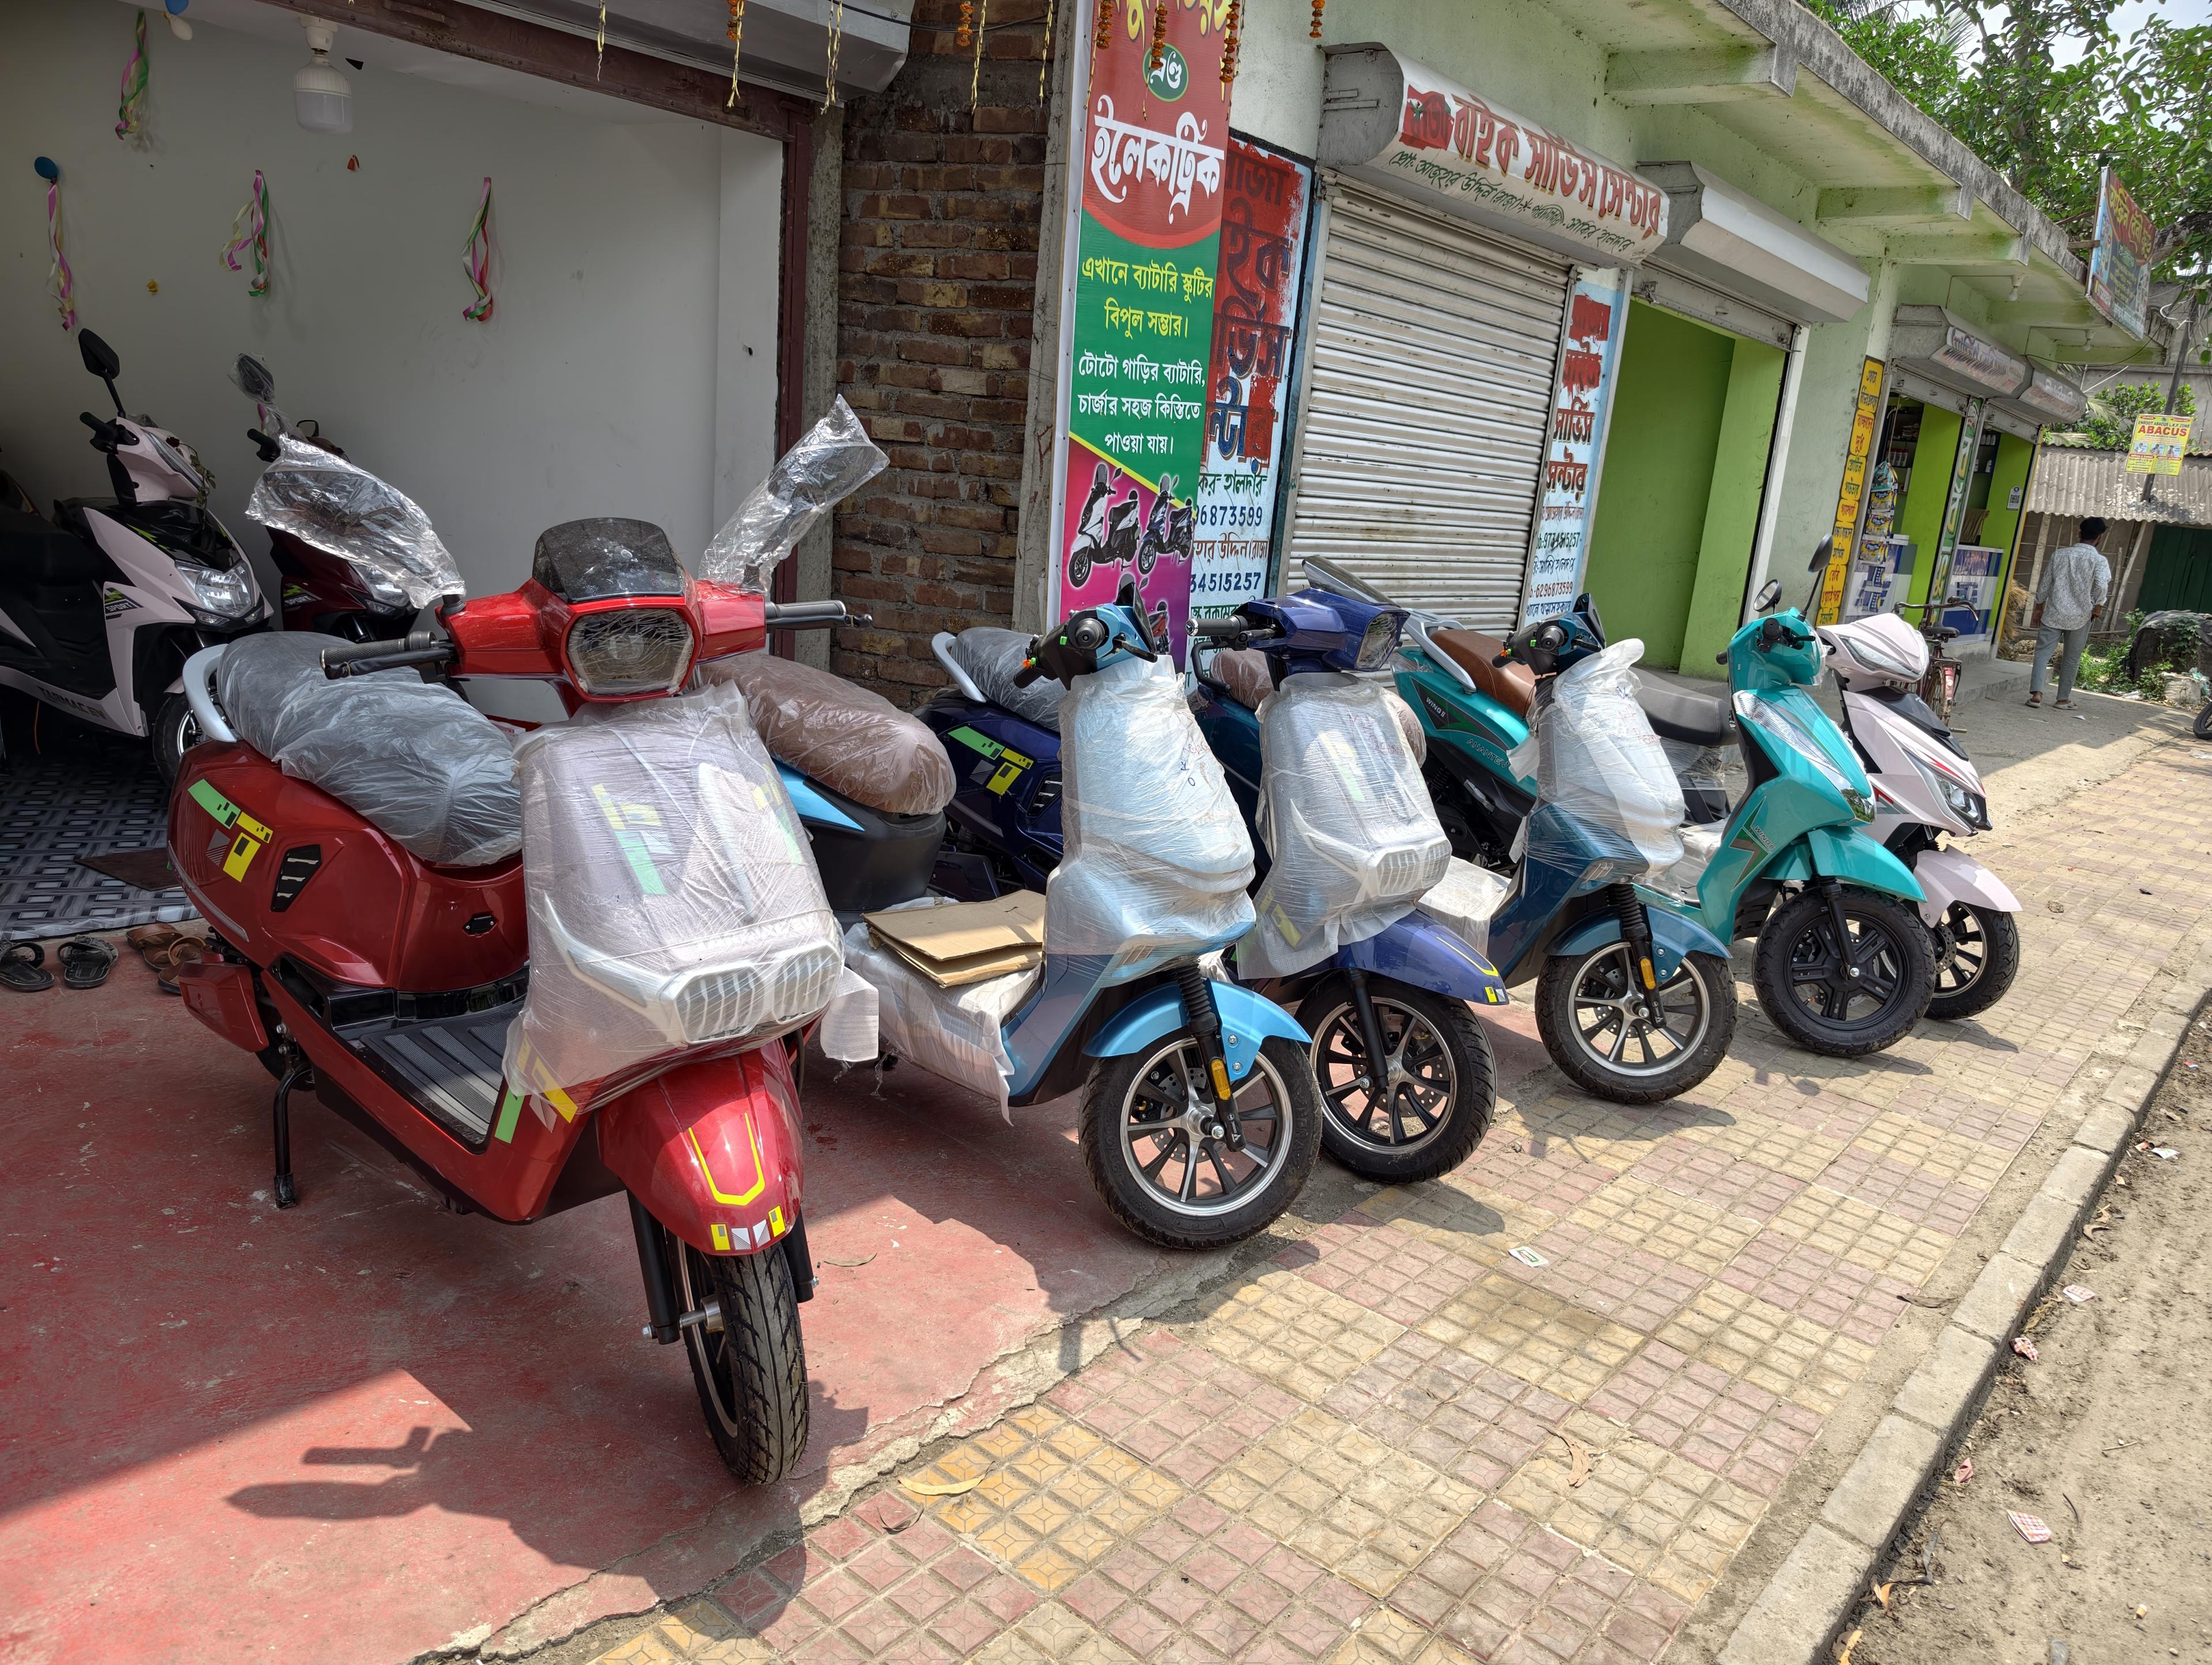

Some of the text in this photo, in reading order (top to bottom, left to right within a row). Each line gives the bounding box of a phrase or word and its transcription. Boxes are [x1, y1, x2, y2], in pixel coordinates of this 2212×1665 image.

[1091, 94, 1225, 224] ইলেকট্রিক
[1082, 255, 1214, 303] এখানে ব্যাটারি স্কুটির
[1104, 297, 1144, 340] বিপুল
[1078, 348, 1206, 387] টোটো গাড়ির ব্যাটারি,
[1078, 388, 1202, 420] চার্জার সহজ কিস্তিতে
[1104, 431, 1174, 456] পাওয়া যায়।
[2138, 425, 2187, 437] ABACUS
[105, 603, 132, 612] SPORT
[1426, 697, 1442, 715] WING
[1467, 738, 1512, 768] ANANTEV
[1754, 825, 1771, 845] WING
